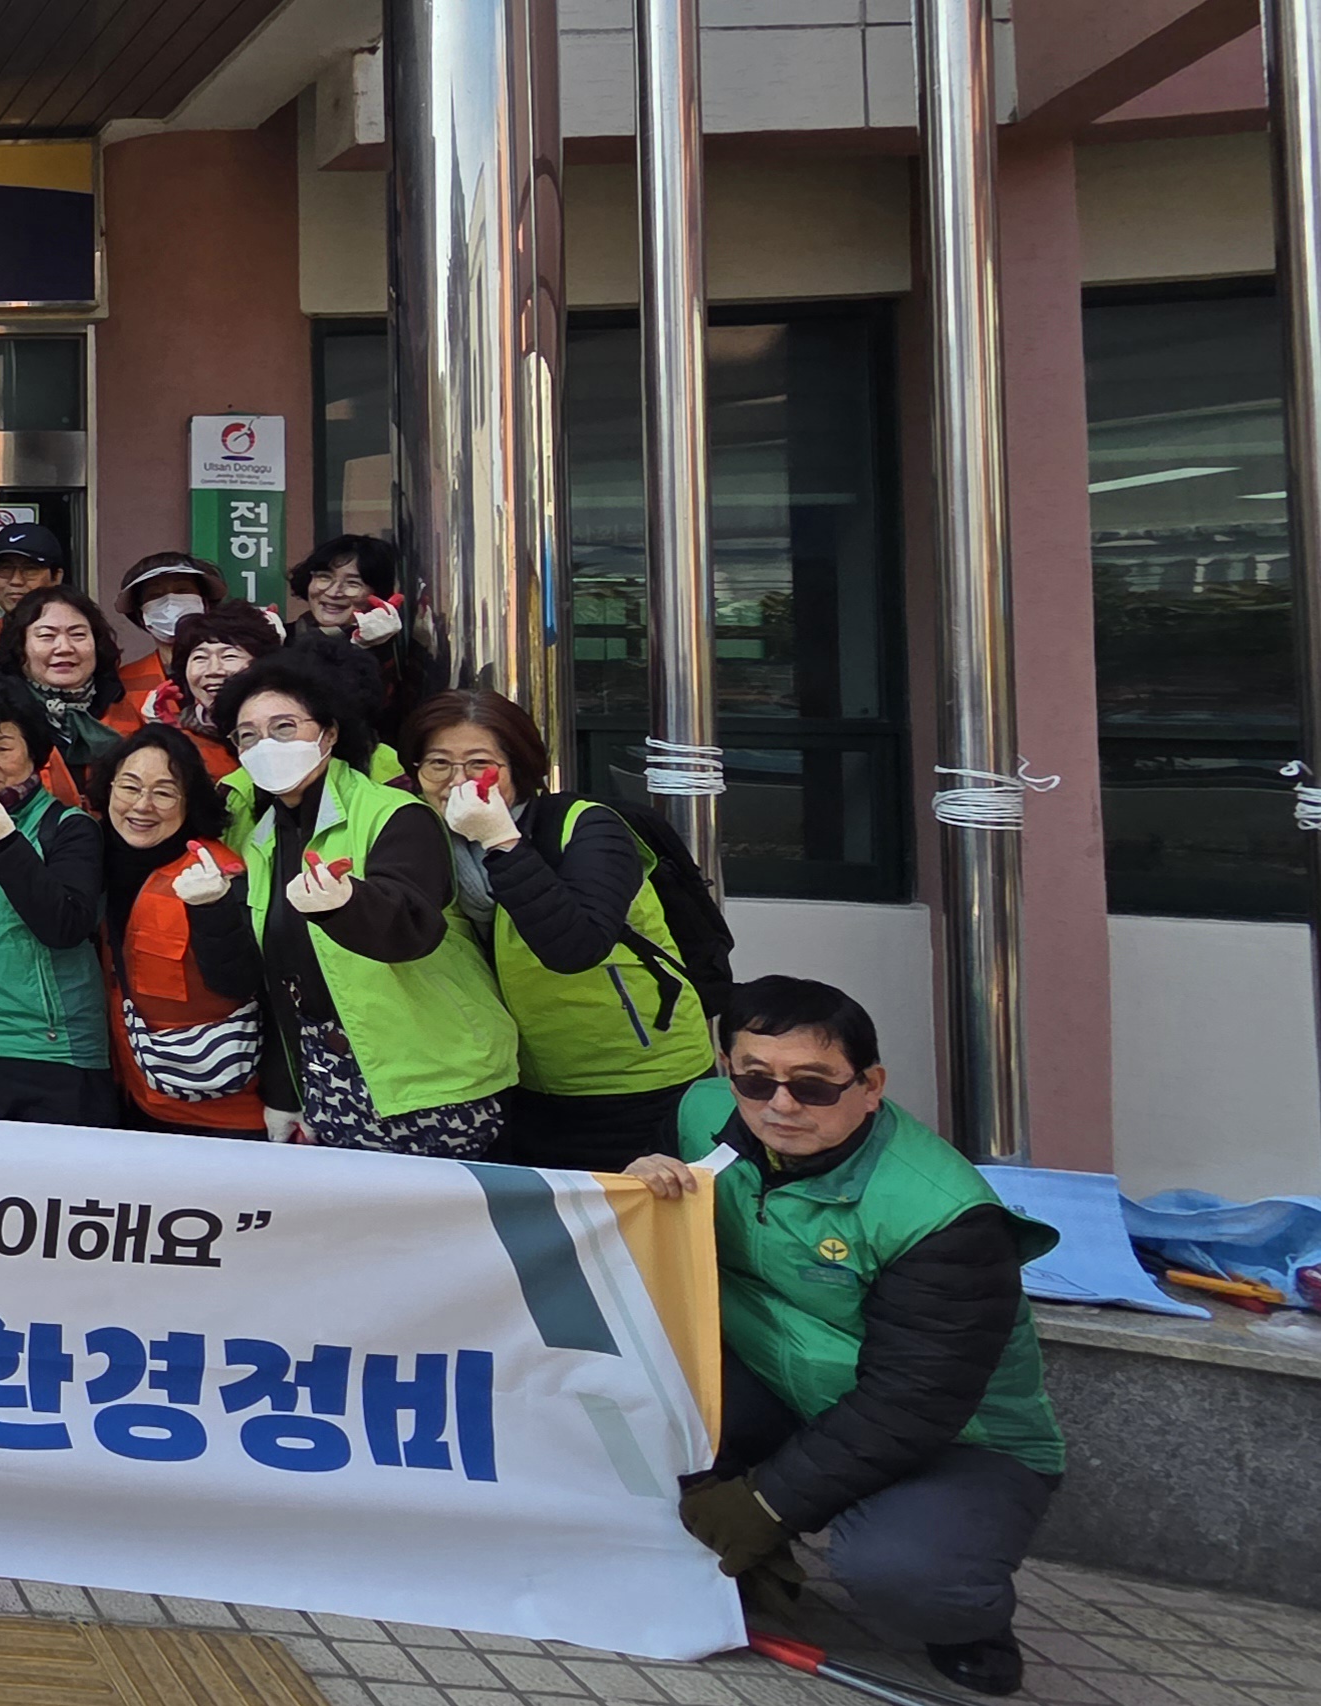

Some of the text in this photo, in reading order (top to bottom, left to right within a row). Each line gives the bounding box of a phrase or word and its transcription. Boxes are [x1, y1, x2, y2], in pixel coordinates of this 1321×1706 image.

[203, 462, 272, 474] Ulsan Donggu
[229, 501, 273, 610] 전하1
